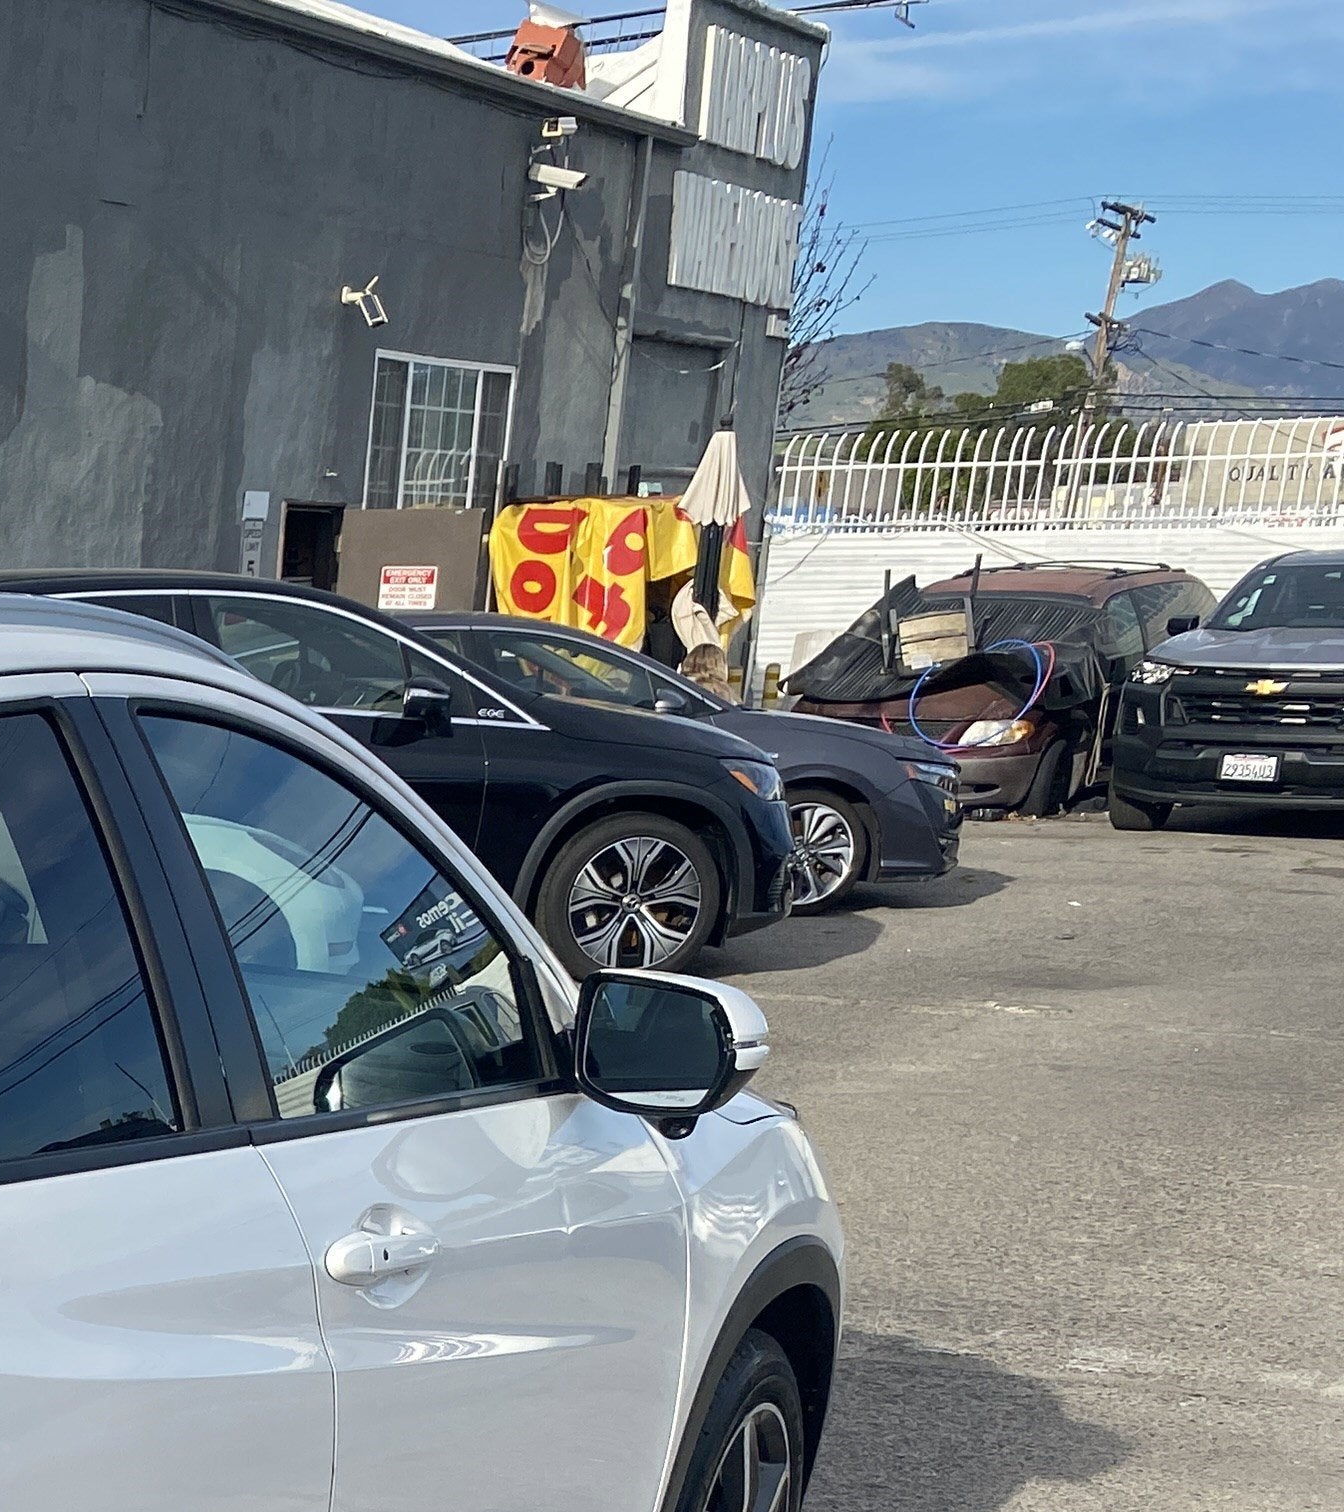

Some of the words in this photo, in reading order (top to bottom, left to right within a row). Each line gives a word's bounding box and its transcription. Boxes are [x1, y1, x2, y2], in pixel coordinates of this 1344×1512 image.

[698, 24, 811, 170] KARPLUS
[667, 170, 805, 311] WAREHOUSE
[1229, 464, 1313, 482] QUALTY
[385, 569, 433, 577] EMERGENCY
[390, 576, 407, 584] EXIT
[407, 576, 428, 584] ONLY
